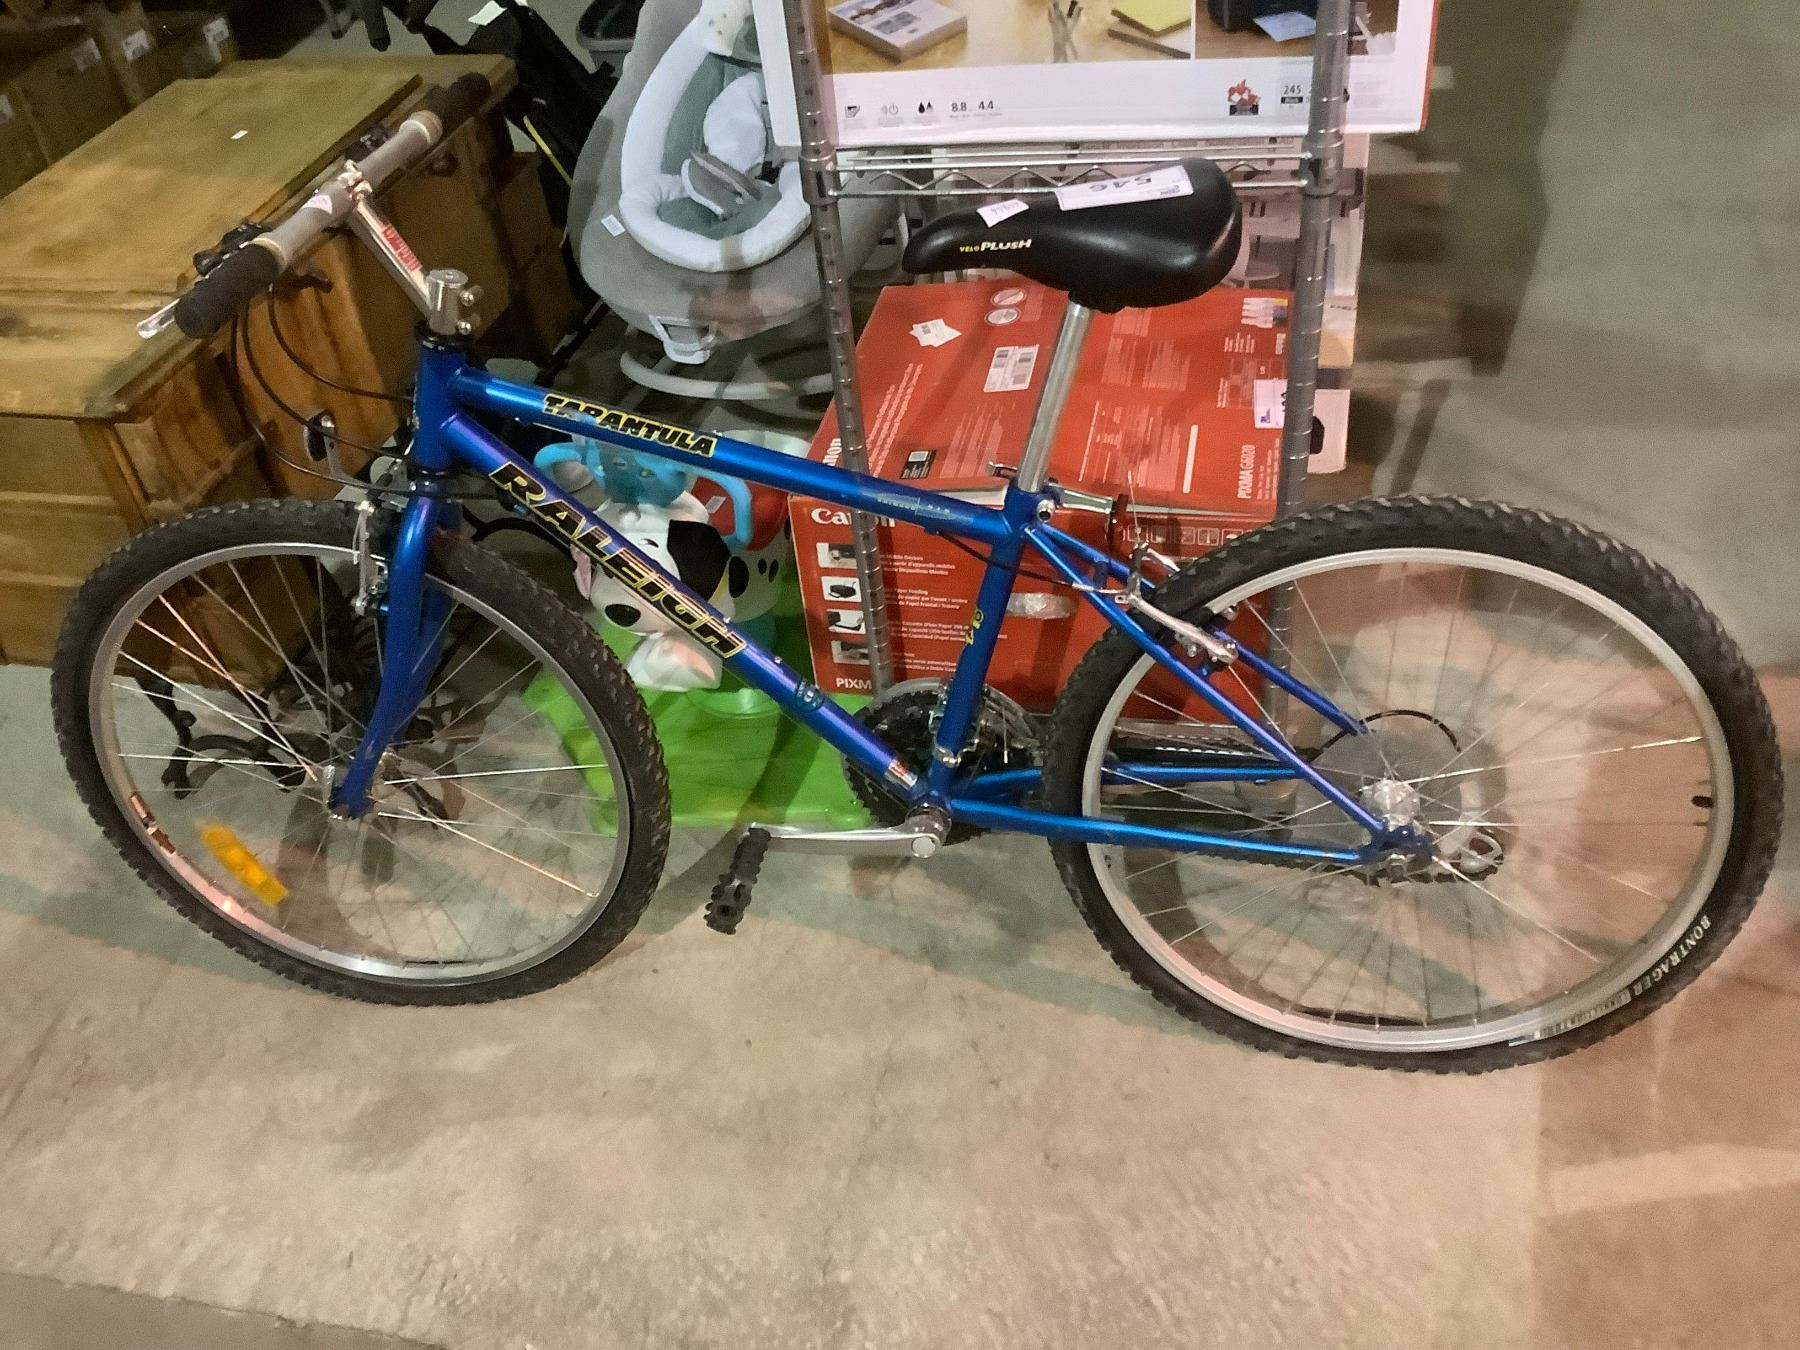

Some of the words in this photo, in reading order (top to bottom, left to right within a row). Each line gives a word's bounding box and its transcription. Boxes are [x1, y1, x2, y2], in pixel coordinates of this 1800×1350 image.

[1283, 84, 1302, 95] 245
[951, 102, 968, 112] 8.8
[976, 100, 995, 111] 4.4
[959, 245, 980, 253] VELO
[980, 238, 1032, 252] PLUSH
[1237, 468, 1254, 499] PIXMA
[488, 461, 747, 659] RALEIGH
[836, 677, 872, 690] PIXM
[1633, 914, 1712, 996] BONTRAGER
